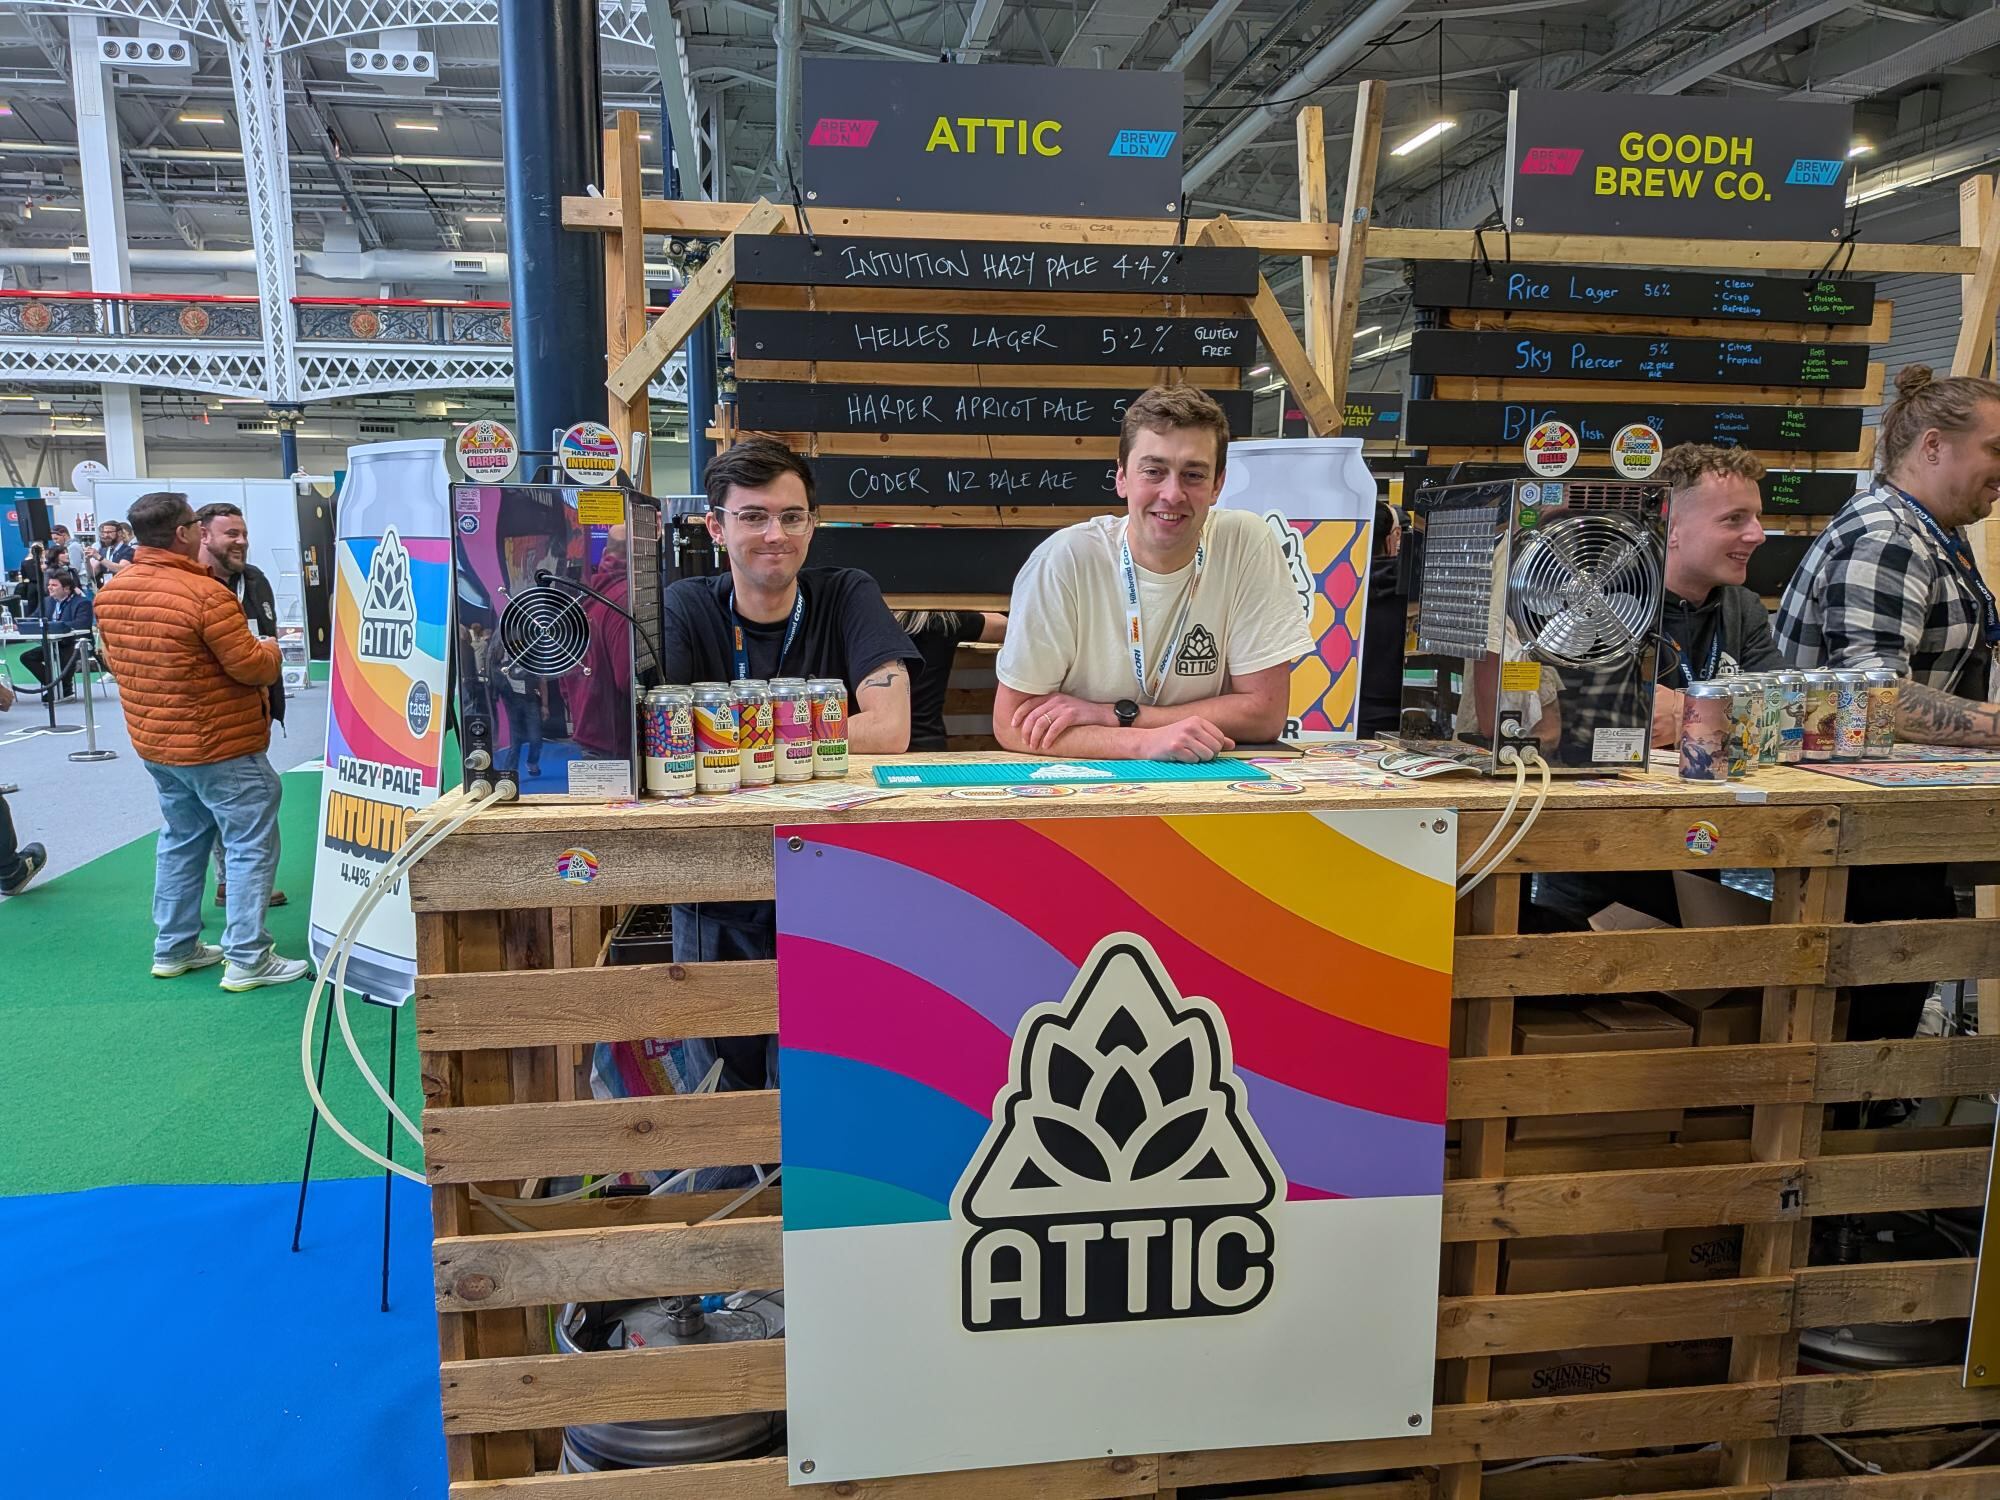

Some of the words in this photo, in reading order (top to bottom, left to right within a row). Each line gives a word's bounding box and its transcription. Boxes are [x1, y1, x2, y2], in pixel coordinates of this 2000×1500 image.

[820, 121, 861, 133] BREW
[925, 116, 1063, 157] ATTIC
[1120, 132, 1160, 144] BREW
[1120, 143, 1149, 155] LDN
[1619, 131, 1754, 167] GOODH
[1795, 161, 1830, 172] BREW
[1594, 166, 1708, 199] BREW
[1714, 171, 1771, 201] CO.
[1794, 172, 1820, 183] LDN
[841, 246, 970, 280] INTUITION
[983, 253, 1036, 286] HAZY
[1047, 254, 1099, 287] PALE
[1507, 273, 1551, 301] Rice
[1569, 276, 1620, 304] Lager
[1724, 280, 1754, 289] Clean
[1817, 281, 1836, 293] Hops
[1722, 293, 1750, 304] Crisp
[1722, 304, 1761, 316] Refreshing
[855, 323, 952, 352] HELLES
[972, 325, 1059, 350] LAGER
[1194, 327, 1239, 343] GLUTEN
[1201, 344, 1232, 357] FREE
[1727, 343, 1753, 351] Citrus
[1515, 341, 1551, 373] Sky
[1571, 342, 1623, 369] Piercer
[1648, 342, 1669, 356] 5%
[848, 394, 943, 425] HARPER
[955, 396, 1038, 423] APRICOT
[1042, 400, 1095, 424] PALE
[467, 455, 508, 468] HARPER
[566, 457, 616, 471] INTUITION
[1537, 452, 1568, 464] HELLES
[1623, 455, 1651, 466] CODER
[848, 467, 929, 498] CODER
[947, 468, 982, 492] NZ
[988, 470, 1031, 492] PALE
[1038, 470, 1078, 491] ALE
[361, 620, 412, 658] ATTIC
[1178, 659, 1217, 673] ATTIC
[409, 701, 430, 717] taste
[786, 747, 812, 759] SIGNA
[338, 758, 379, 787] HAZY
[381, 767, 422, 795] PALE
[340, 862, 371, 888] 4.4%
[568, 869, 590, 879] ATTIC
[971, 1215, 1267, 1325] ATTIC
